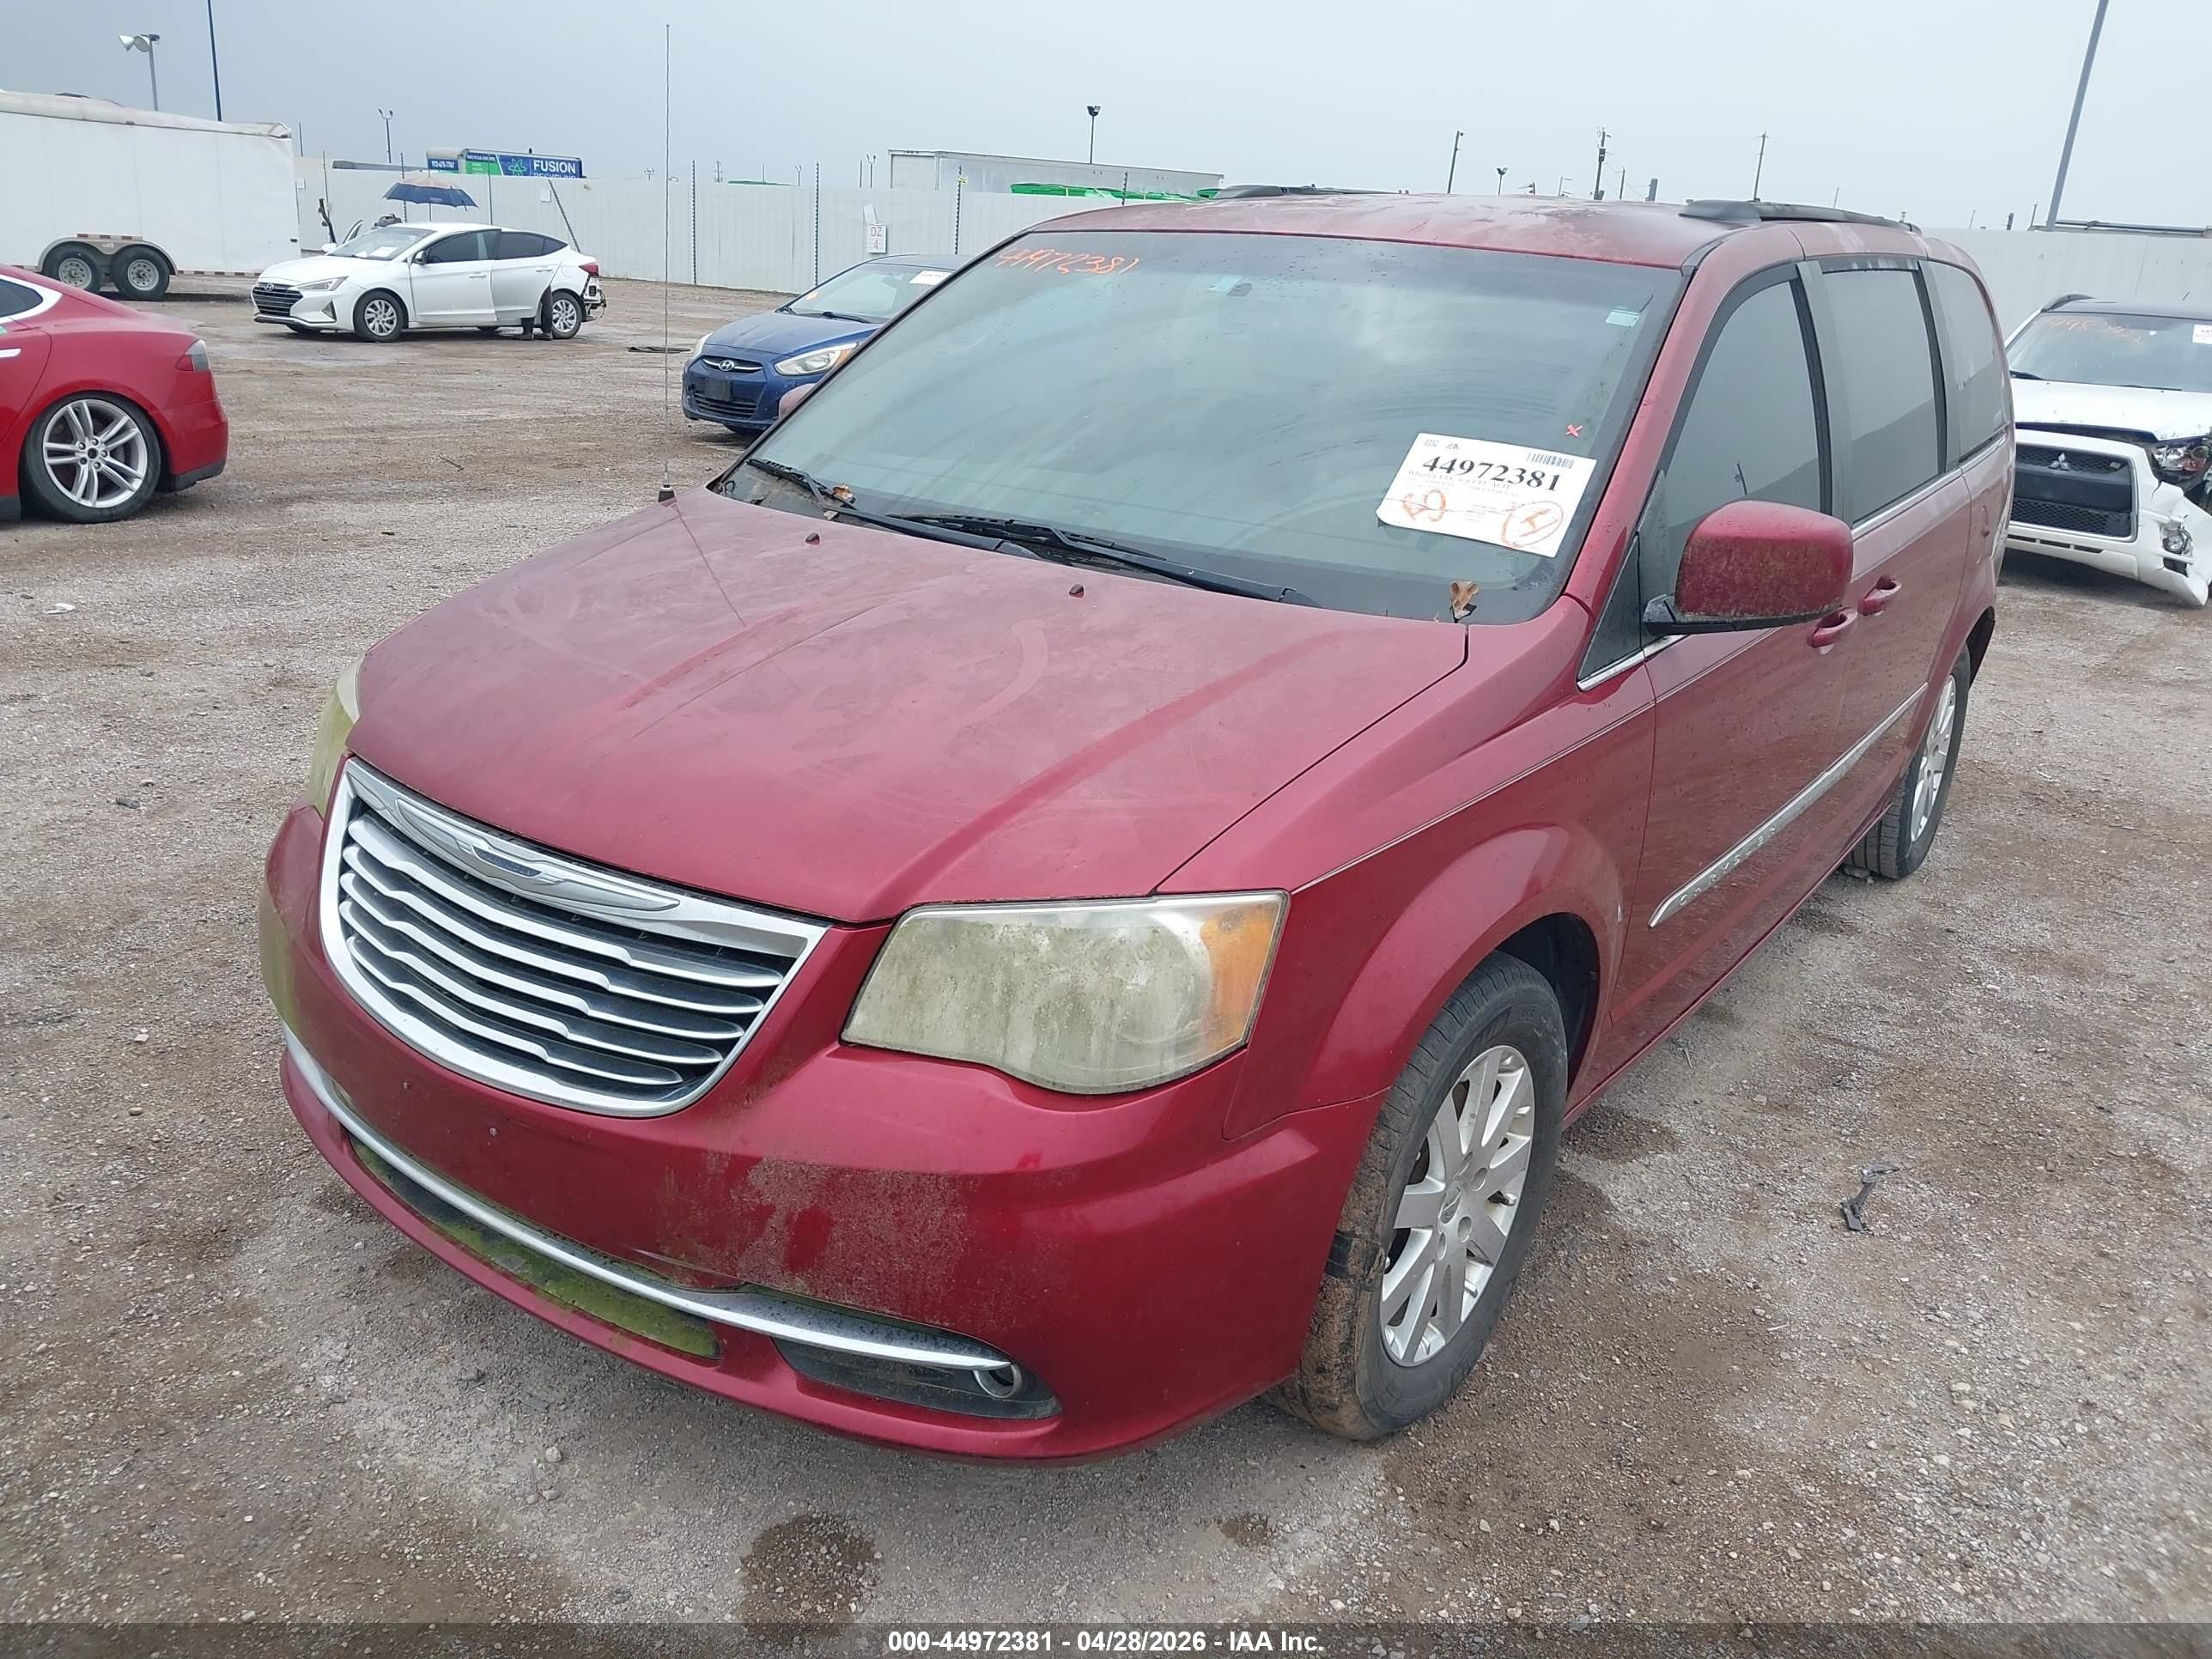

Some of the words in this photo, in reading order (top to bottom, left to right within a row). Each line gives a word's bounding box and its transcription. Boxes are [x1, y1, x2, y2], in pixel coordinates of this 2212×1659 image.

[532, 159, 577, 173] FUSION
[873, 240, 878, 250] 4
[1422, 455, 1562, 492] 44972381
